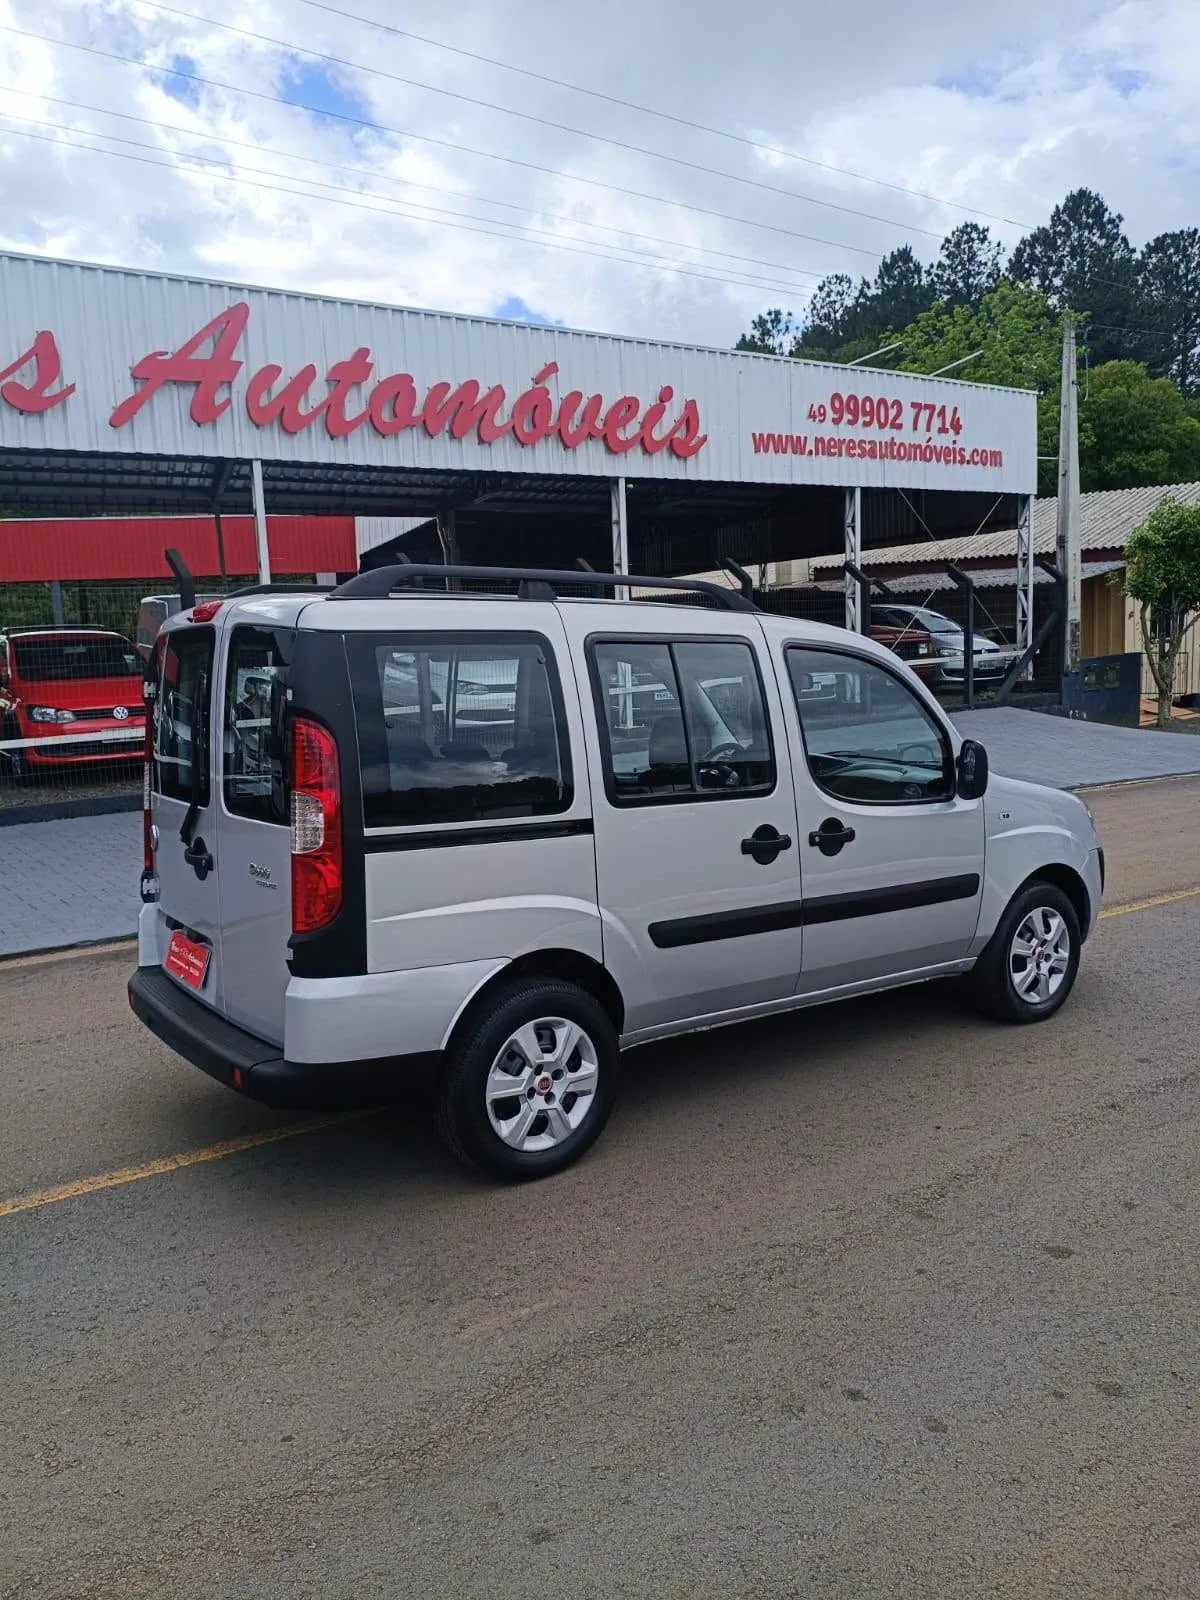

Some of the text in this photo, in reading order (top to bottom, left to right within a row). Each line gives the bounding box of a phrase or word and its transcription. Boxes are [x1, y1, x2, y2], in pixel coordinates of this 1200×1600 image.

[110, 302, 708, 458] Automóveis
[808, 393, 963, 435] 49 99902 7714
[752, 432, 1003, 467] www.neresautomóveis.com
